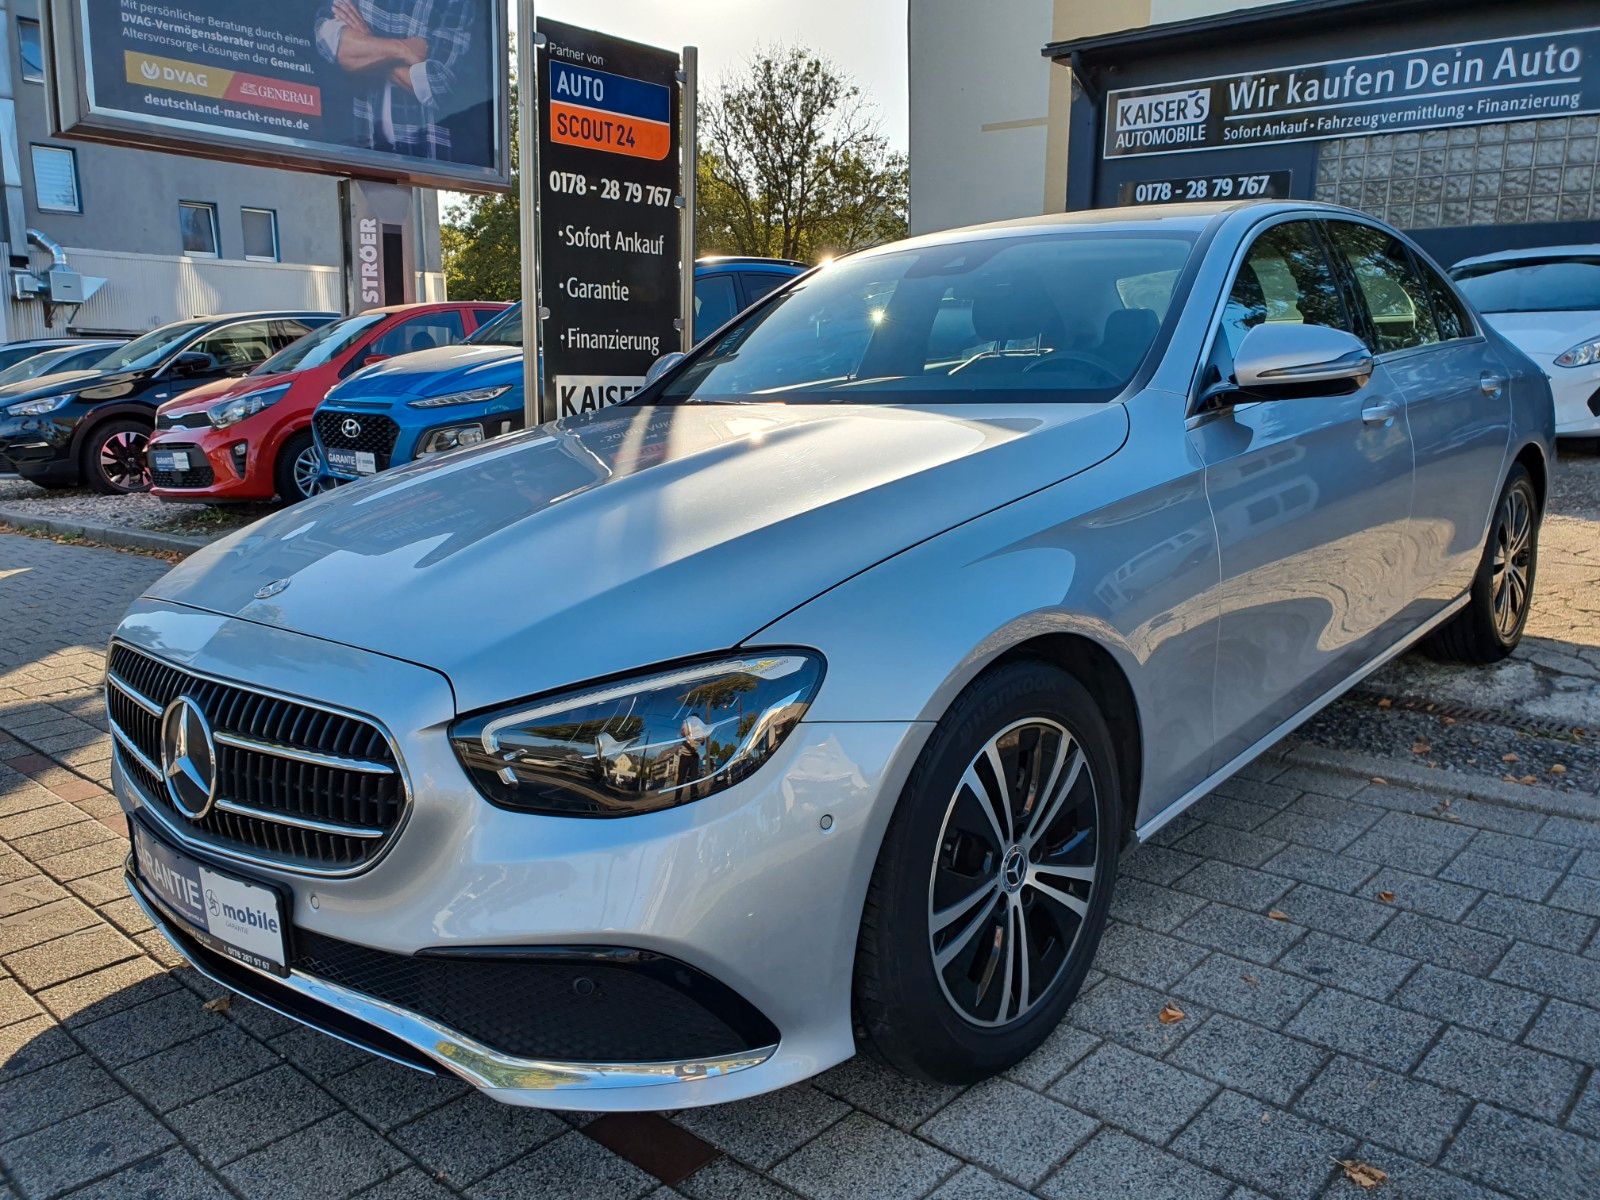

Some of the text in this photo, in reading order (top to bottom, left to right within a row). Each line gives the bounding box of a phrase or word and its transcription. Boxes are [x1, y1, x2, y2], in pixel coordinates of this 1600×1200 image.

[120, 0, 311, 47] Mit persönlicher Beratung durch einen
[121, 12, 295, 57] DVAG-Vermögensberater und den
[122, 27, 315, 75] Altersvorsorge-Lösungen der Generali.
[550, 42, 604, 66] Partner von
[163, 67, 208, 88] DVAG
[557, 70, 604, 102] AUTO
[1229, 43, 1580, 111] Wir kaufen Dein Auto
[144, 93, 310, 131] deutschland-macht-rente.de
[257, 85, 315, 107] GENERALI
[557, 112, 636, 148] SCOUT 24
[1224, 92, 1581, 141] Sofort Ankauf Fahrzeugvermittlung Finanzierung
[1116, 124, 1207, 149] AUTOMOBILE
[549, 171, 587, 196] 0178
[600, 178, 620, 201] 28
[624, 182, 643, 204] 79
[646, 185, 672, 208] 767
[1135, 182, 1172, 202] 0178
[1186, 179, 1207, 199] 28
[1212, 178, 1233, 197] 79
[1238, 175, 1271, 196] 767
[565, 224, 664, 256] Sofort Ankauf
[566, 276, 630, 302] Garantie
[567, 327, 660, 356] Finanzierung
[222, 901, 278, 934] mobile
